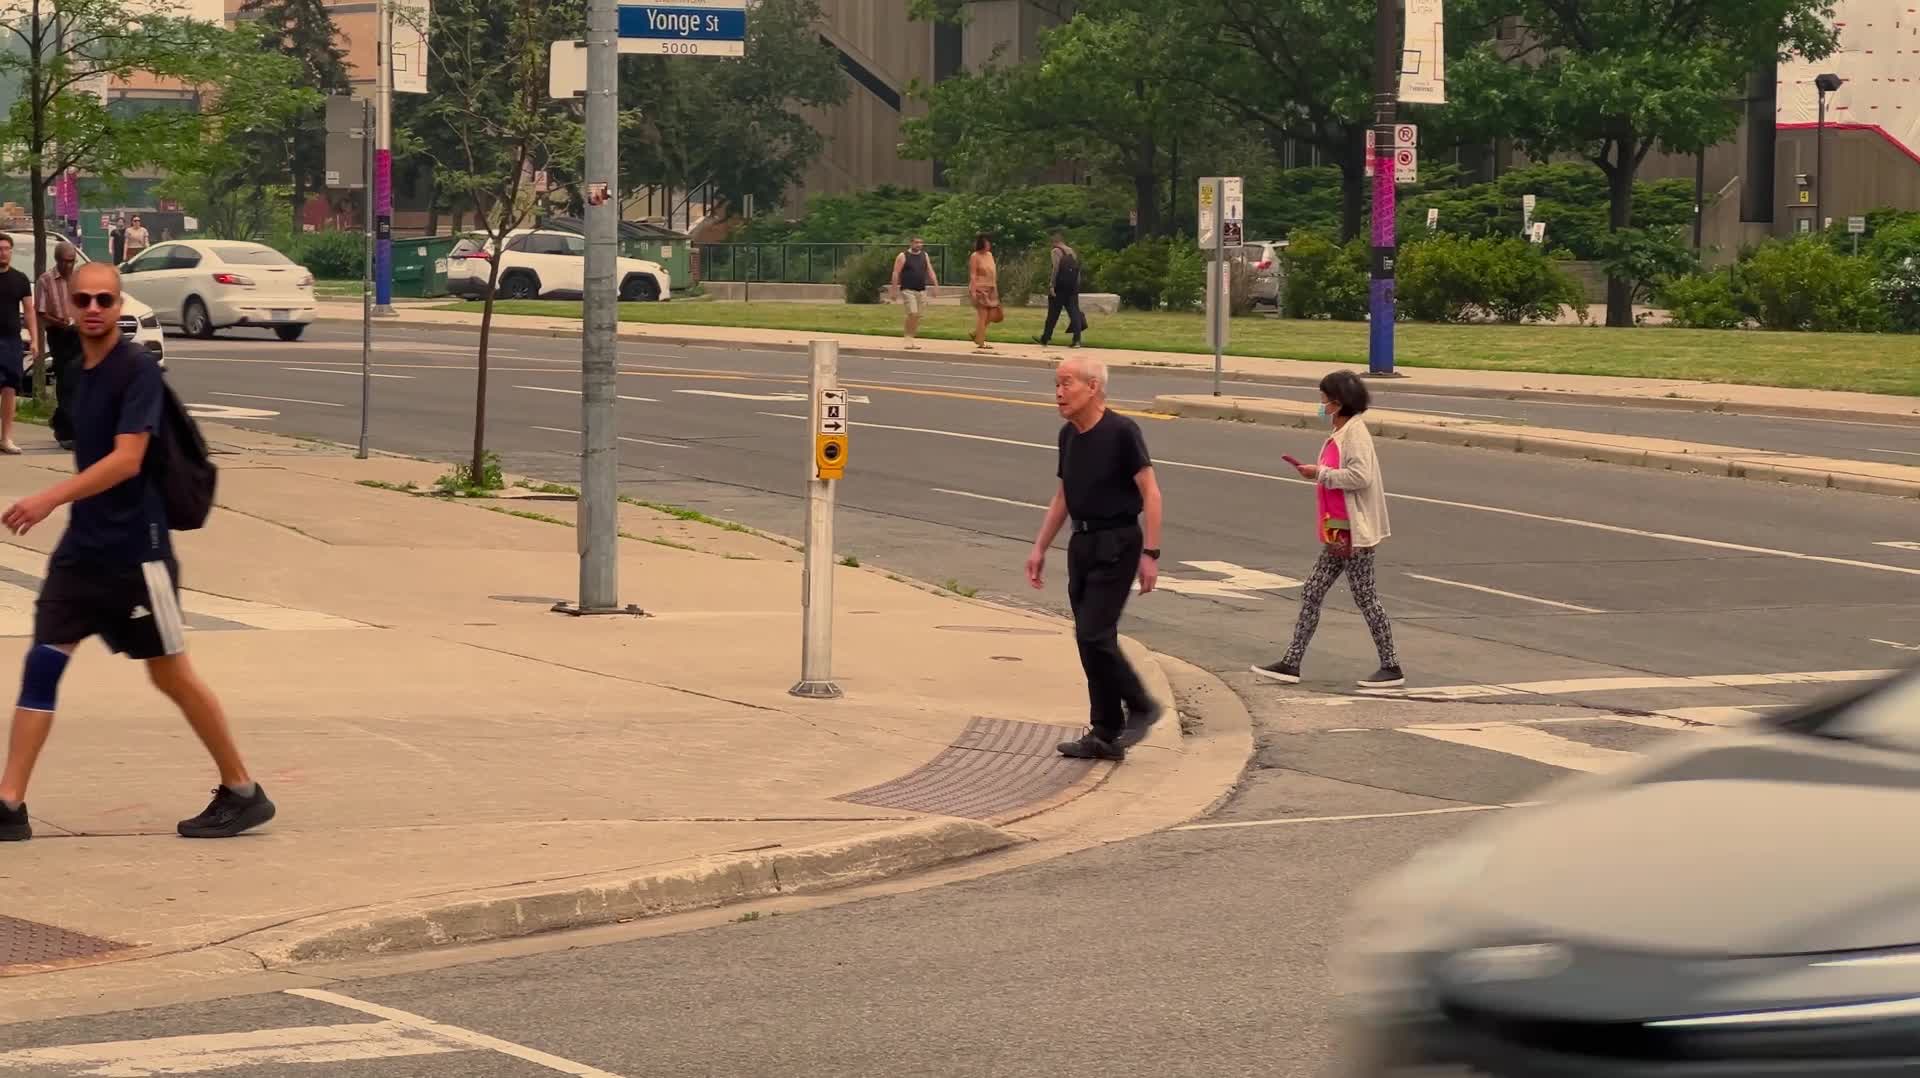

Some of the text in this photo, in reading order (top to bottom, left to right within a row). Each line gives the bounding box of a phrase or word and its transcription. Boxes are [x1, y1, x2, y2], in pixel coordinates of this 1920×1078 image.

[647, 9, 719, 36] Yonge St
[662, 43, 698, 54] 5000
